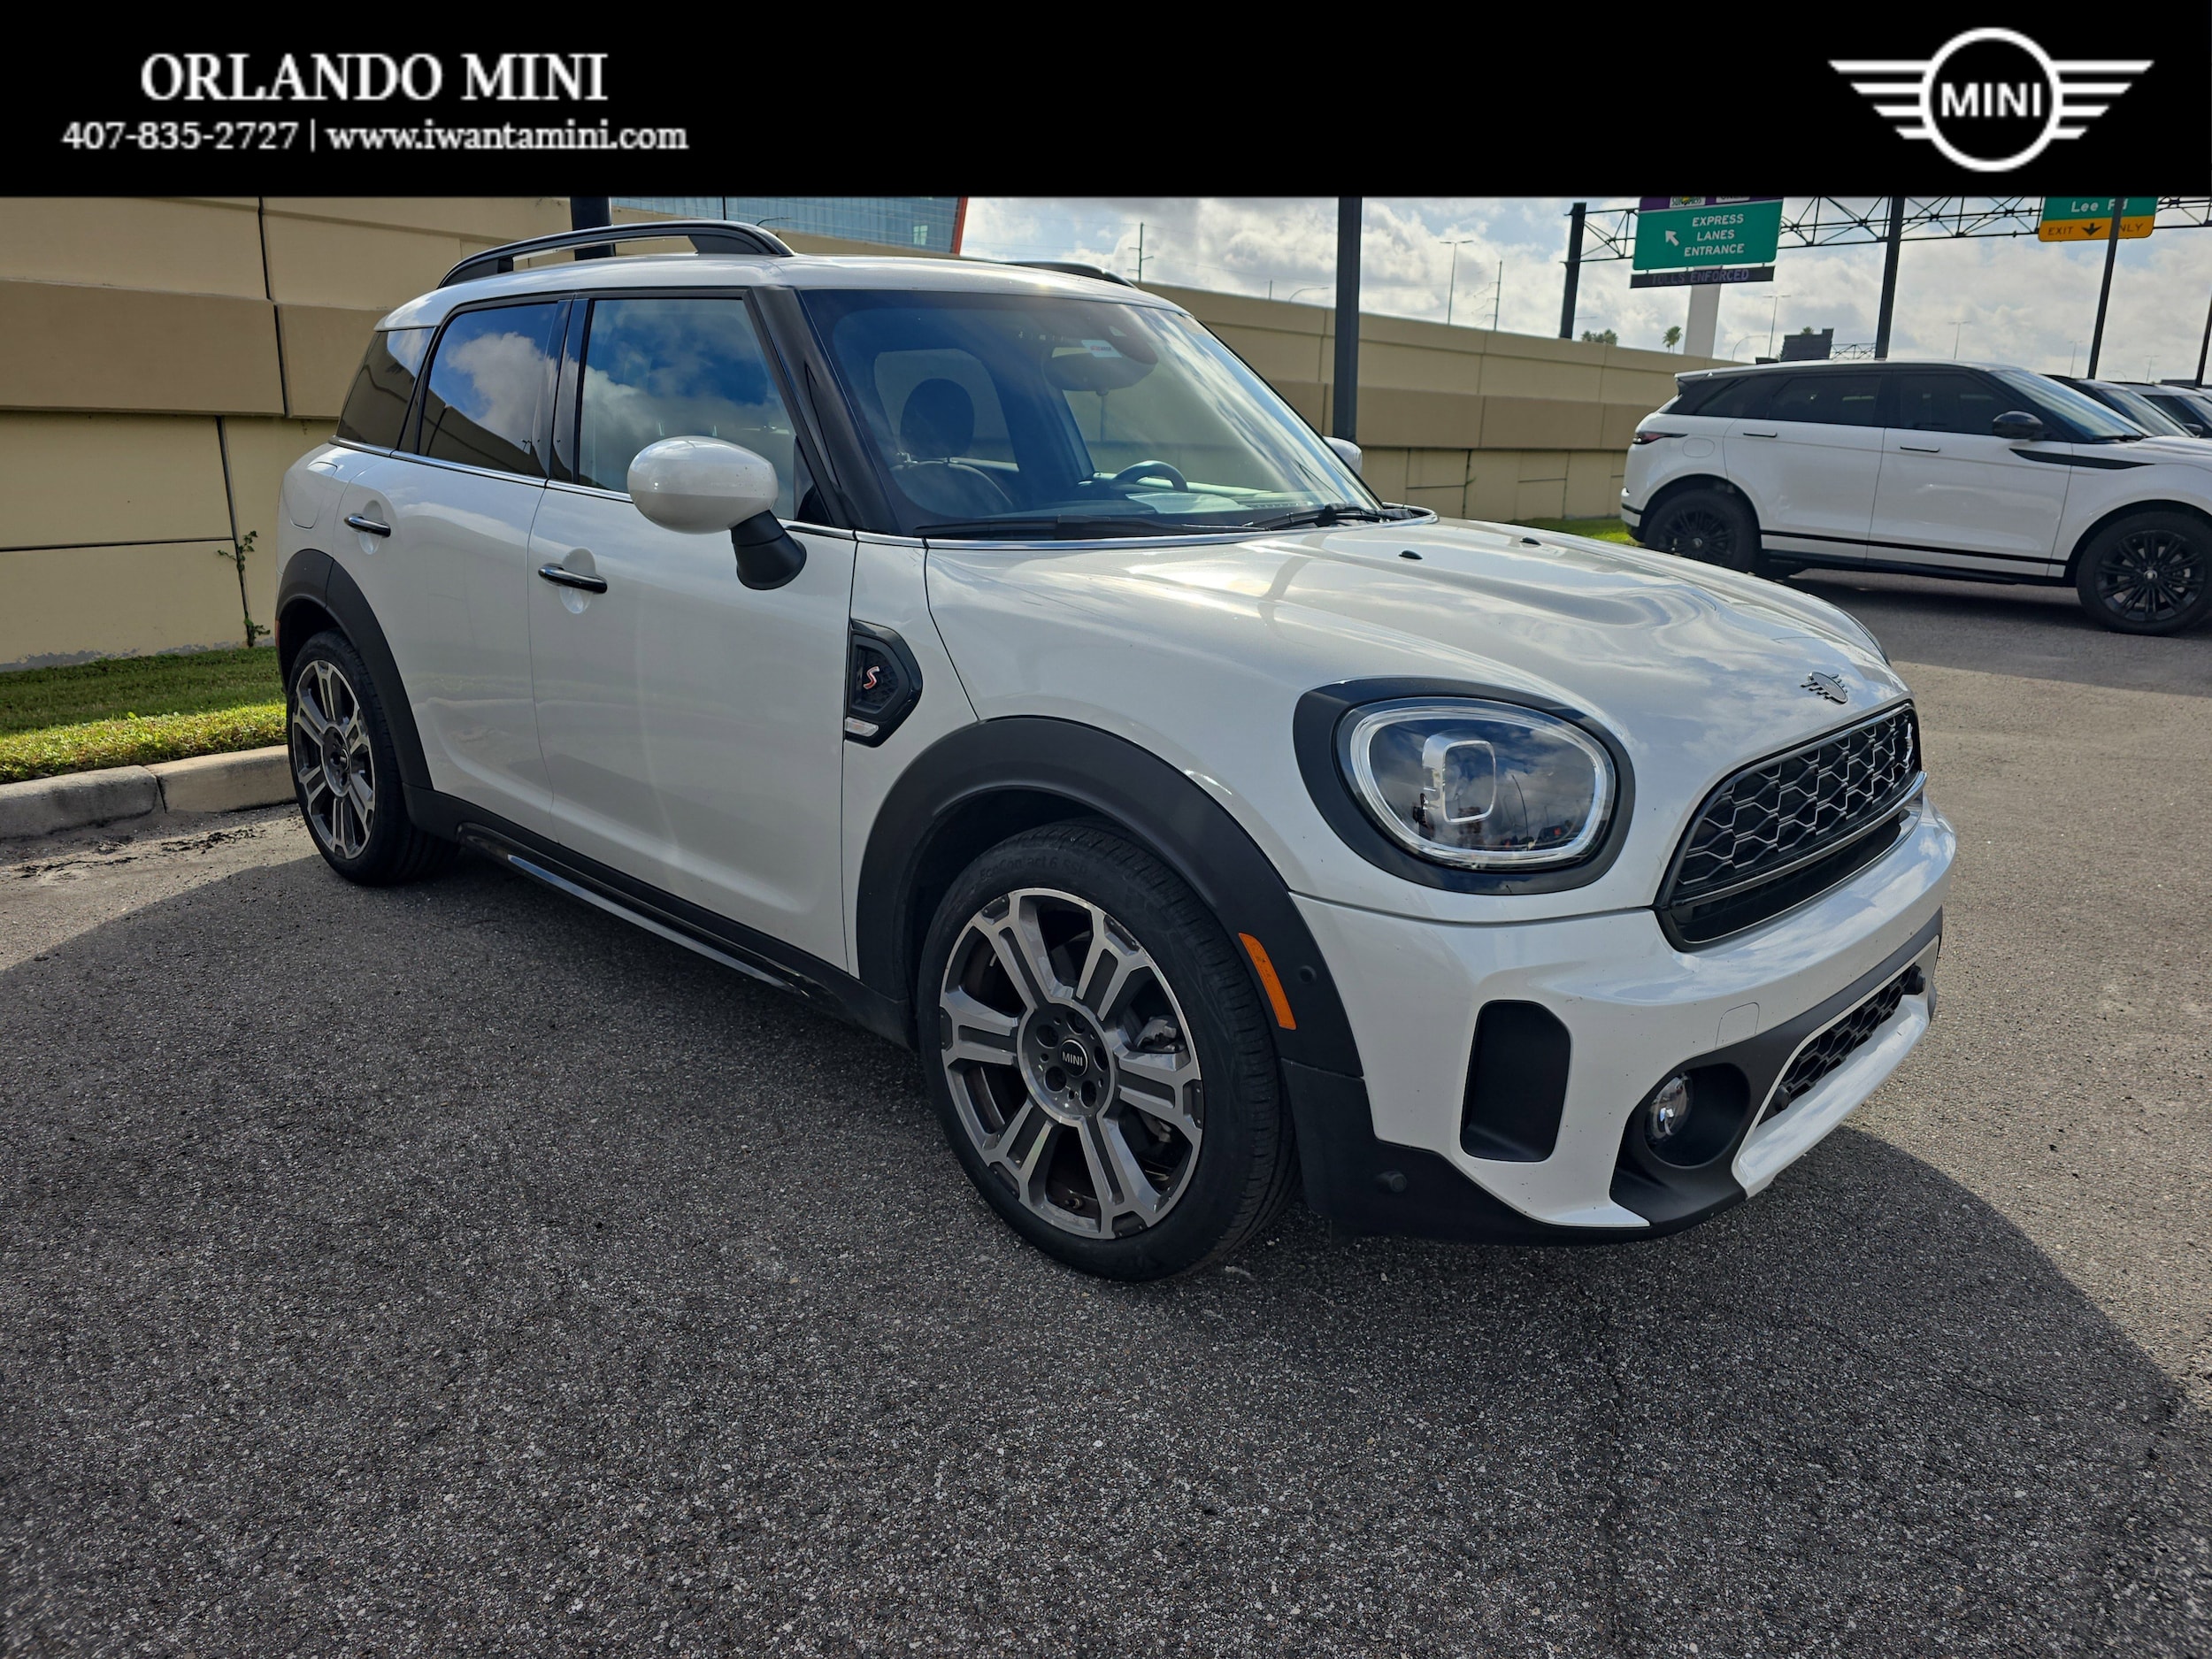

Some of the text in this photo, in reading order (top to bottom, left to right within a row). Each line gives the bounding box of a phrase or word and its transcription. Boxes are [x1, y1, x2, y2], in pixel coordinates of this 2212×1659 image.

[2070, 201, 2099, 212] Lee
[1692, 213, 1745, 227] EXPRESS
[1696, 229, 1735, 242] LANES
[2047, 226, 2074, 235] EXIT
[1684, 243, 1746, 257] ENTRANCE
[1651, 268, 1749, 285] TOLLS ENFORCED
[1062, 1051, 1083, 1066] MINI
